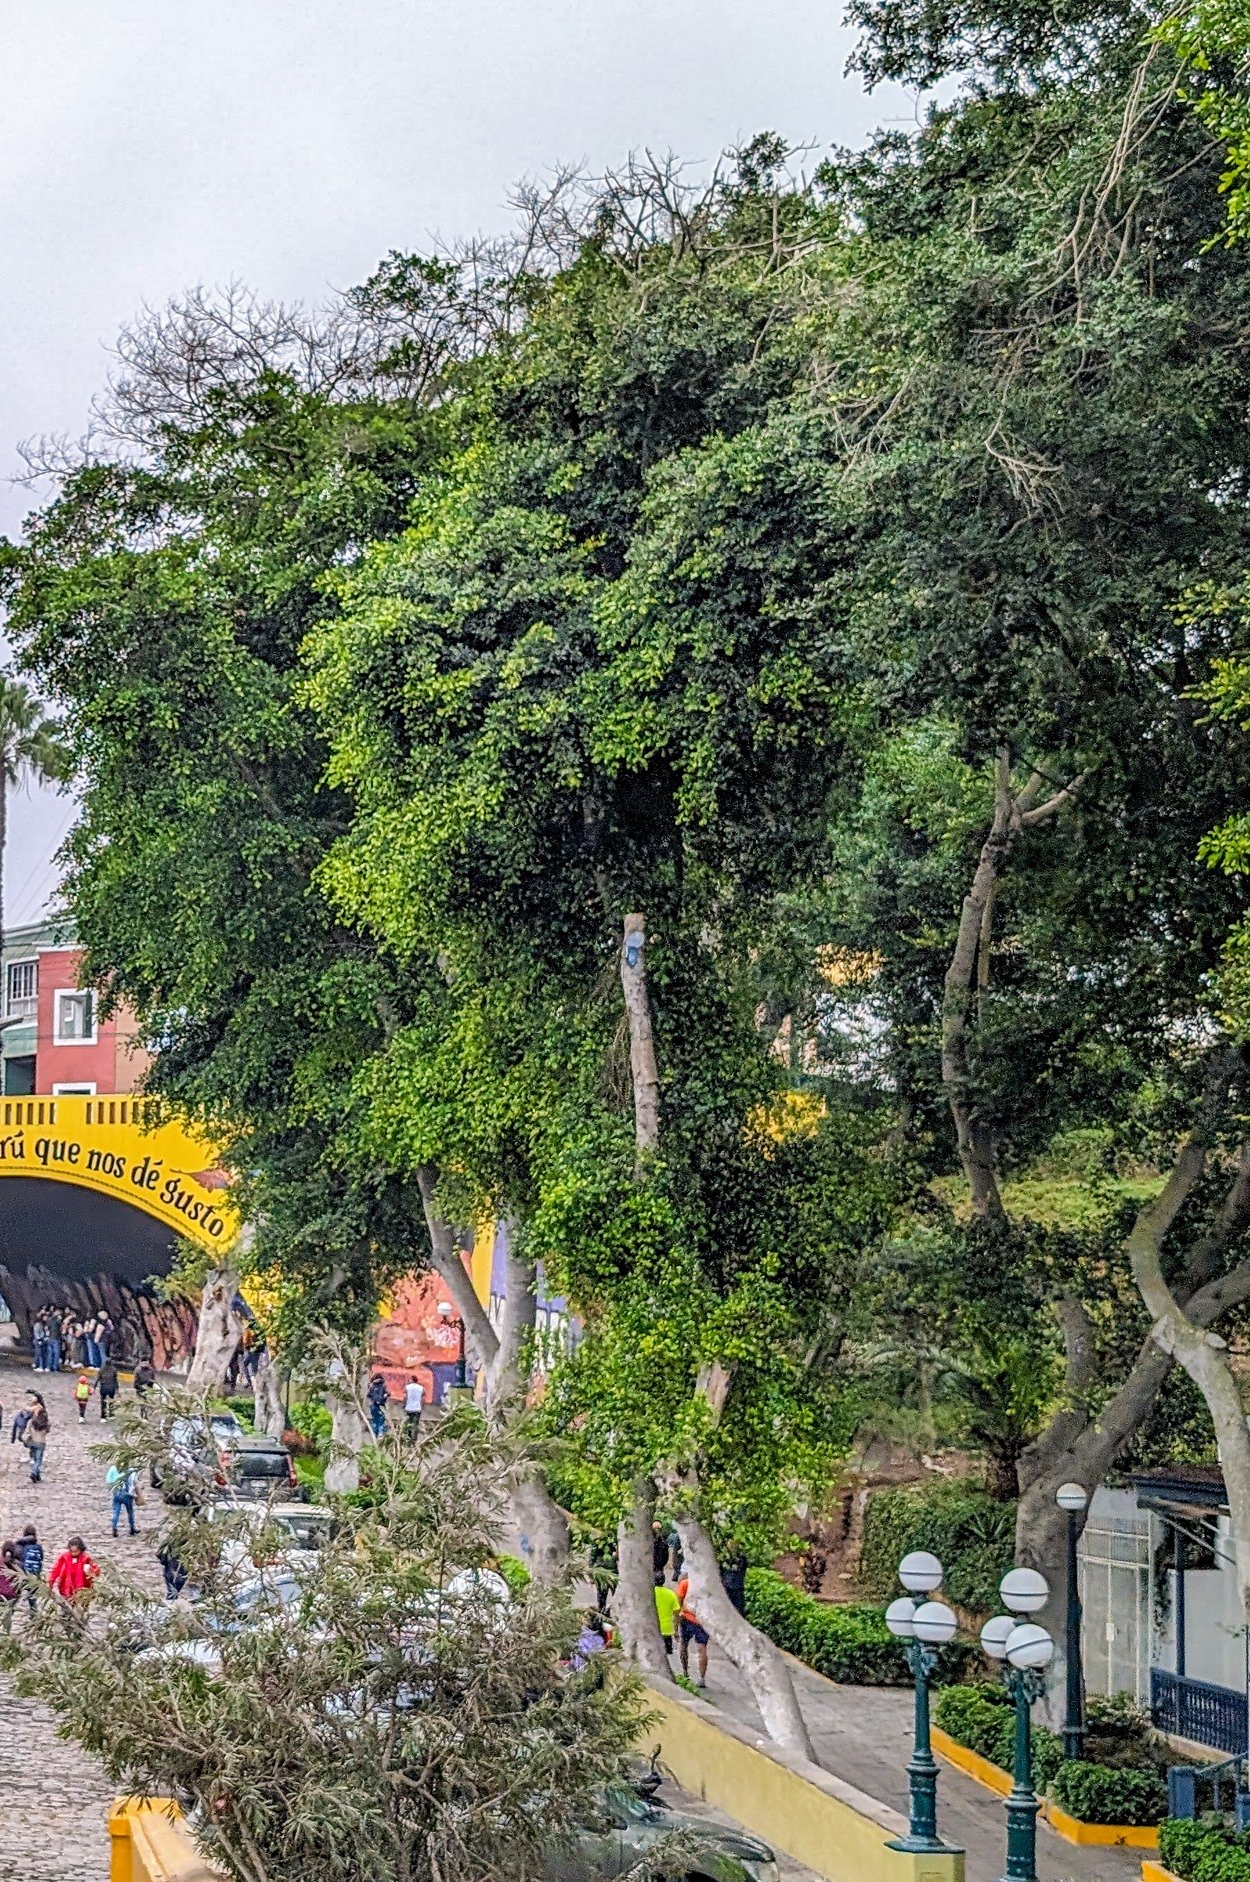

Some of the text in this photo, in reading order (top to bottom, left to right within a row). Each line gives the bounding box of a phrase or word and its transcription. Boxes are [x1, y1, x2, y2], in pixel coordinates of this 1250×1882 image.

[35, 1137, 81, 1166] que
[86, 1149, 126, 1178] nos
[131, 1156, 163, 1190] dé
[159, 1178, 224, 1237] gusto
